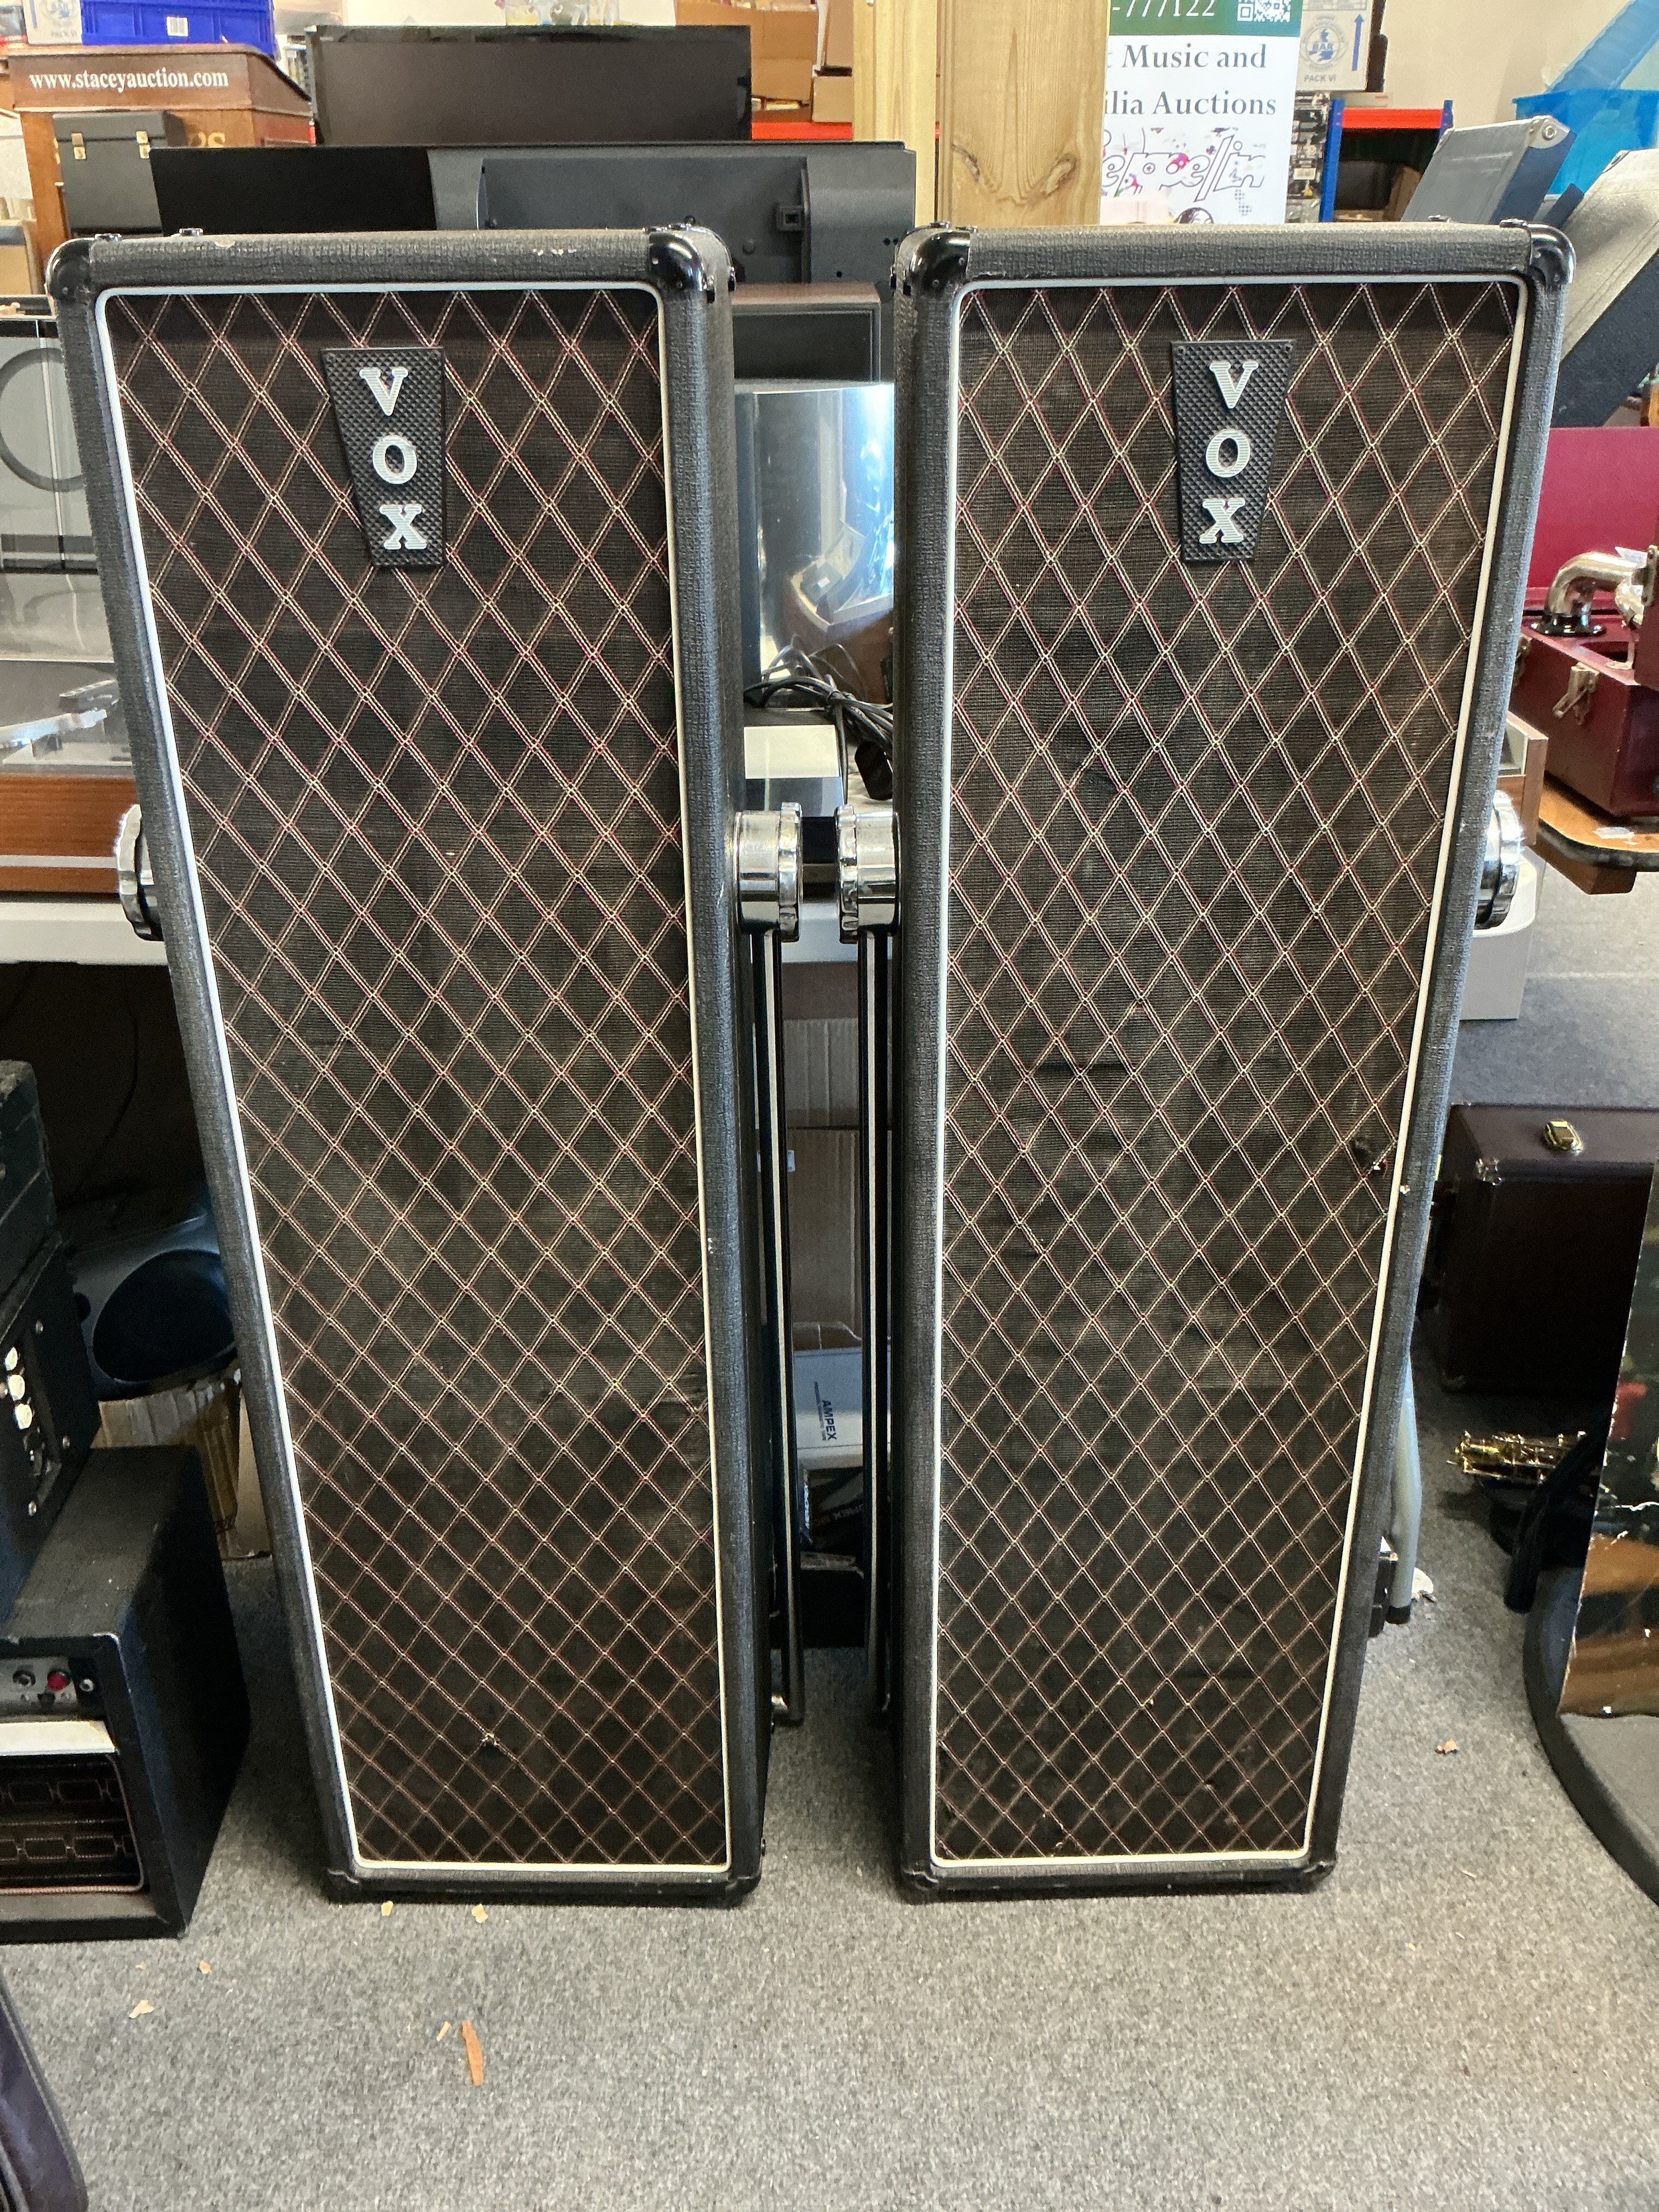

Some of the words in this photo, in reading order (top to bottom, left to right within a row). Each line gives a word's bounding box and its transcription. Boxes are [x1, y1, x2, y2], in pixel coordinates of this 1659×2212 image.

[1121, 43, 1209, 68] Music
[1216, 44, 1267, 68] and
[29, 67, 229, 94] www.staceyauction.com
[1152, 90, 1277, 115] Auctions
[359, 367, 427, 550] VOX
[1199, 360, 1259, 545] VOX
[822, 1400, 837, 1441] AMPEX
